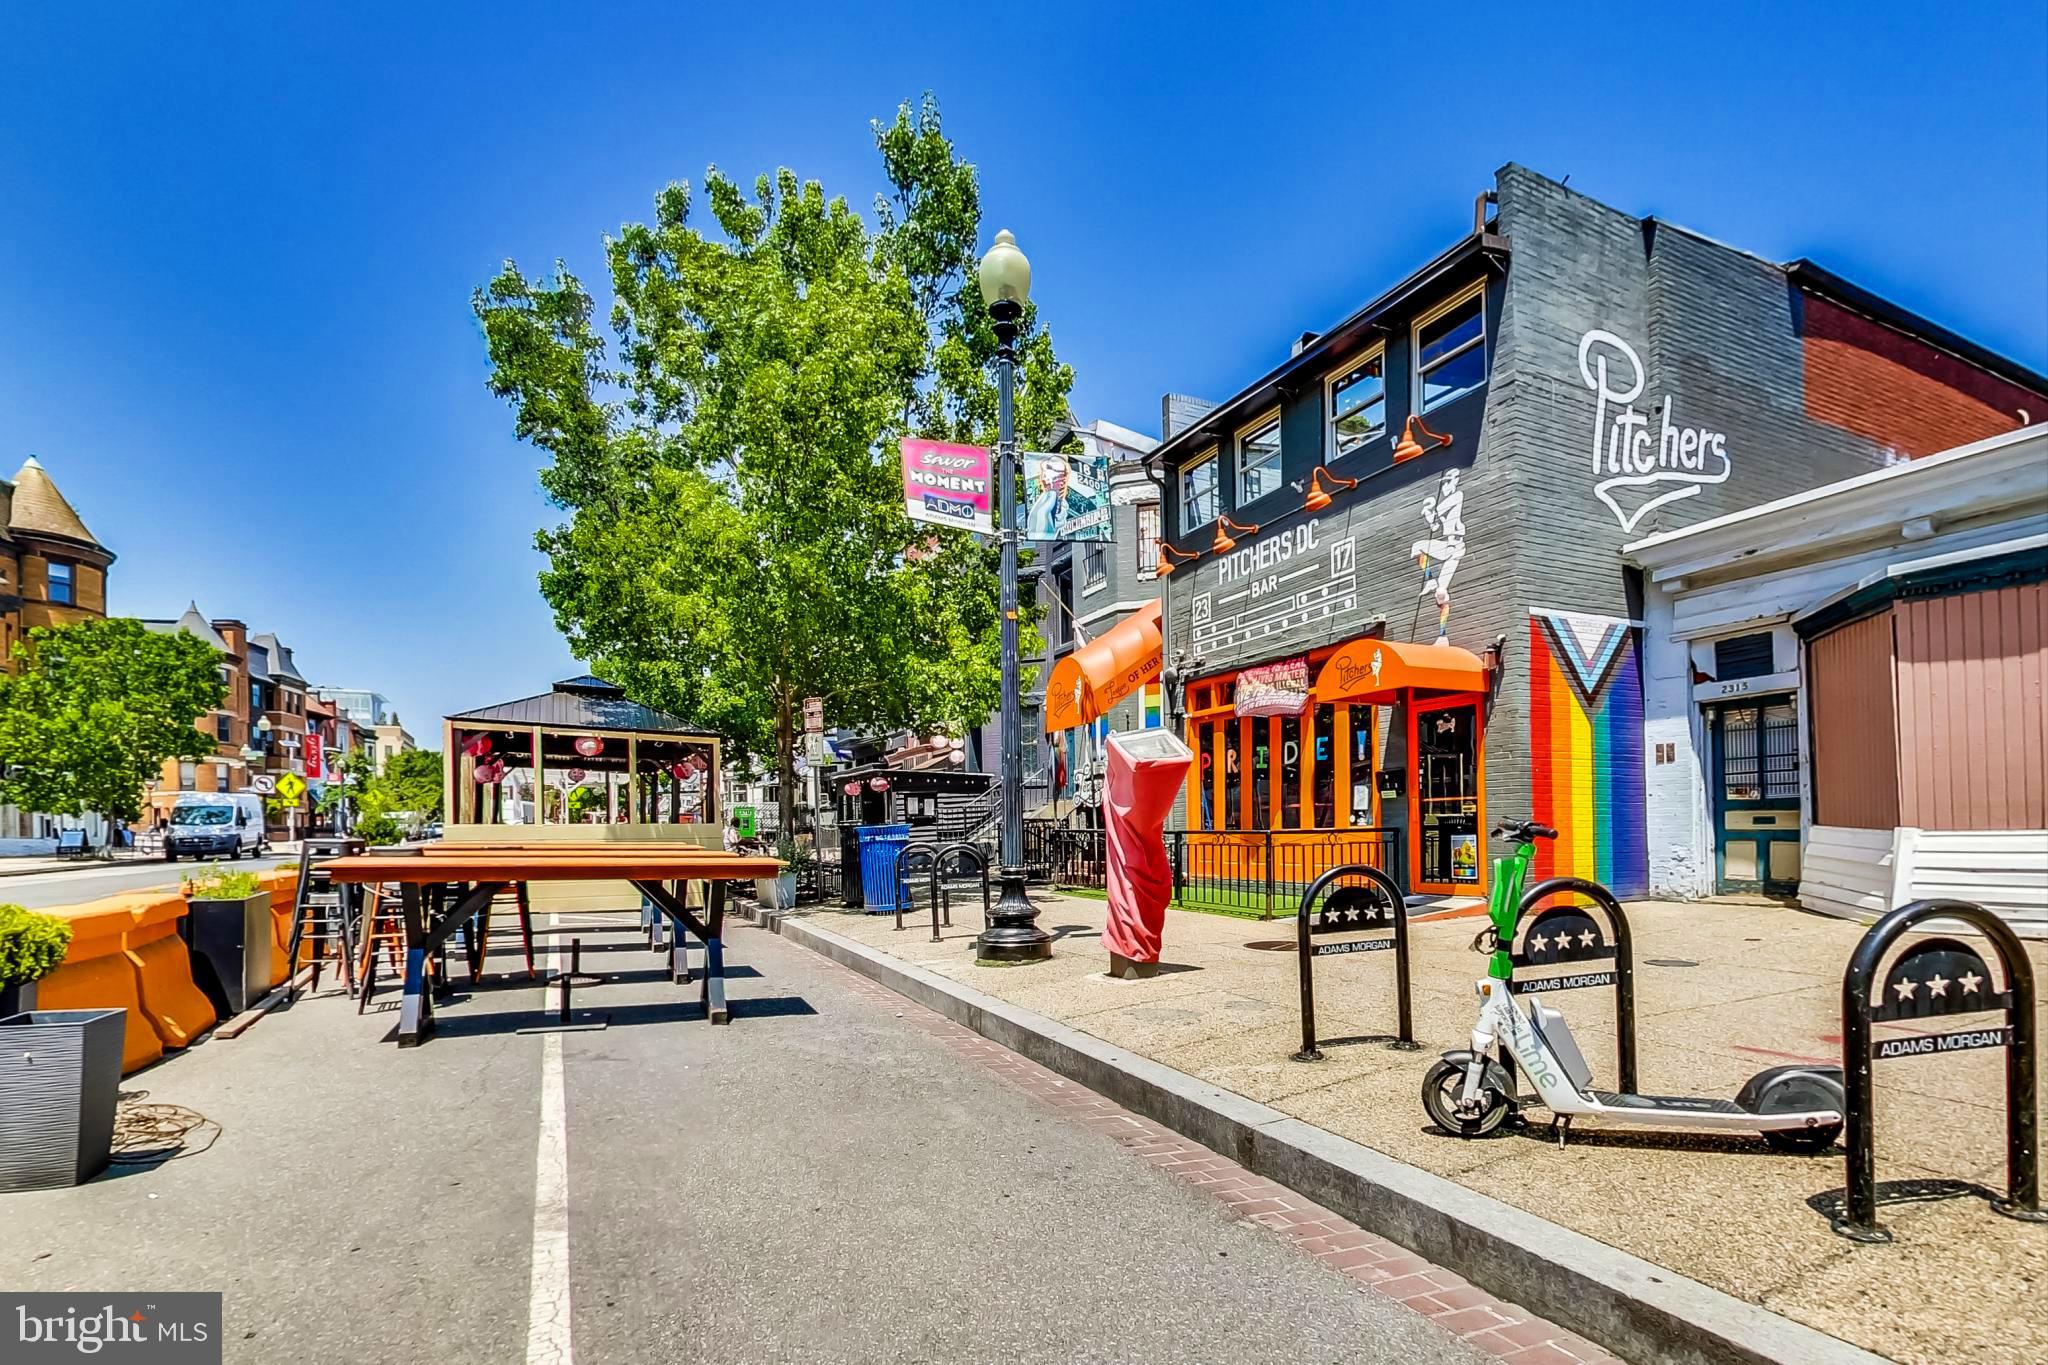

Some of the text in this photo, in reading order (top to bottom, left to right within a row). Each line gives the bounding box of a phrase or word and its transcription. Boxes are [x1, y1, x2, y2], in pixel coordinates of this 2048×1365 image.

[1578, 329, 1732, 486] Pitchers
[908, 467, 986, 493] MOMENT
[1218, 518, 1320, 586] PITCHERS DC
[1334, 543, 1352, 571] 17
[1251, 575, 1278, 599] BAR
[1195, 598, 1209, 620] 23
[1128, 671, 1139, 683] OF
[1141, 657, 1159, 674] HER
[1275, 669, 1306, 682] MATTER
[1336, 656, 1373, 686] Pitchers
[1721, 682, 1748, 693] 2315
[1318, 939, 1391, 956] ADAMS MORGAN
[1522, 973, 1611, 993] ADAMS MORGAN
[1880, 1031, 2002, 1057] ADAMS MORGAN
[1515, 1033, 1558, 1089] Lime
